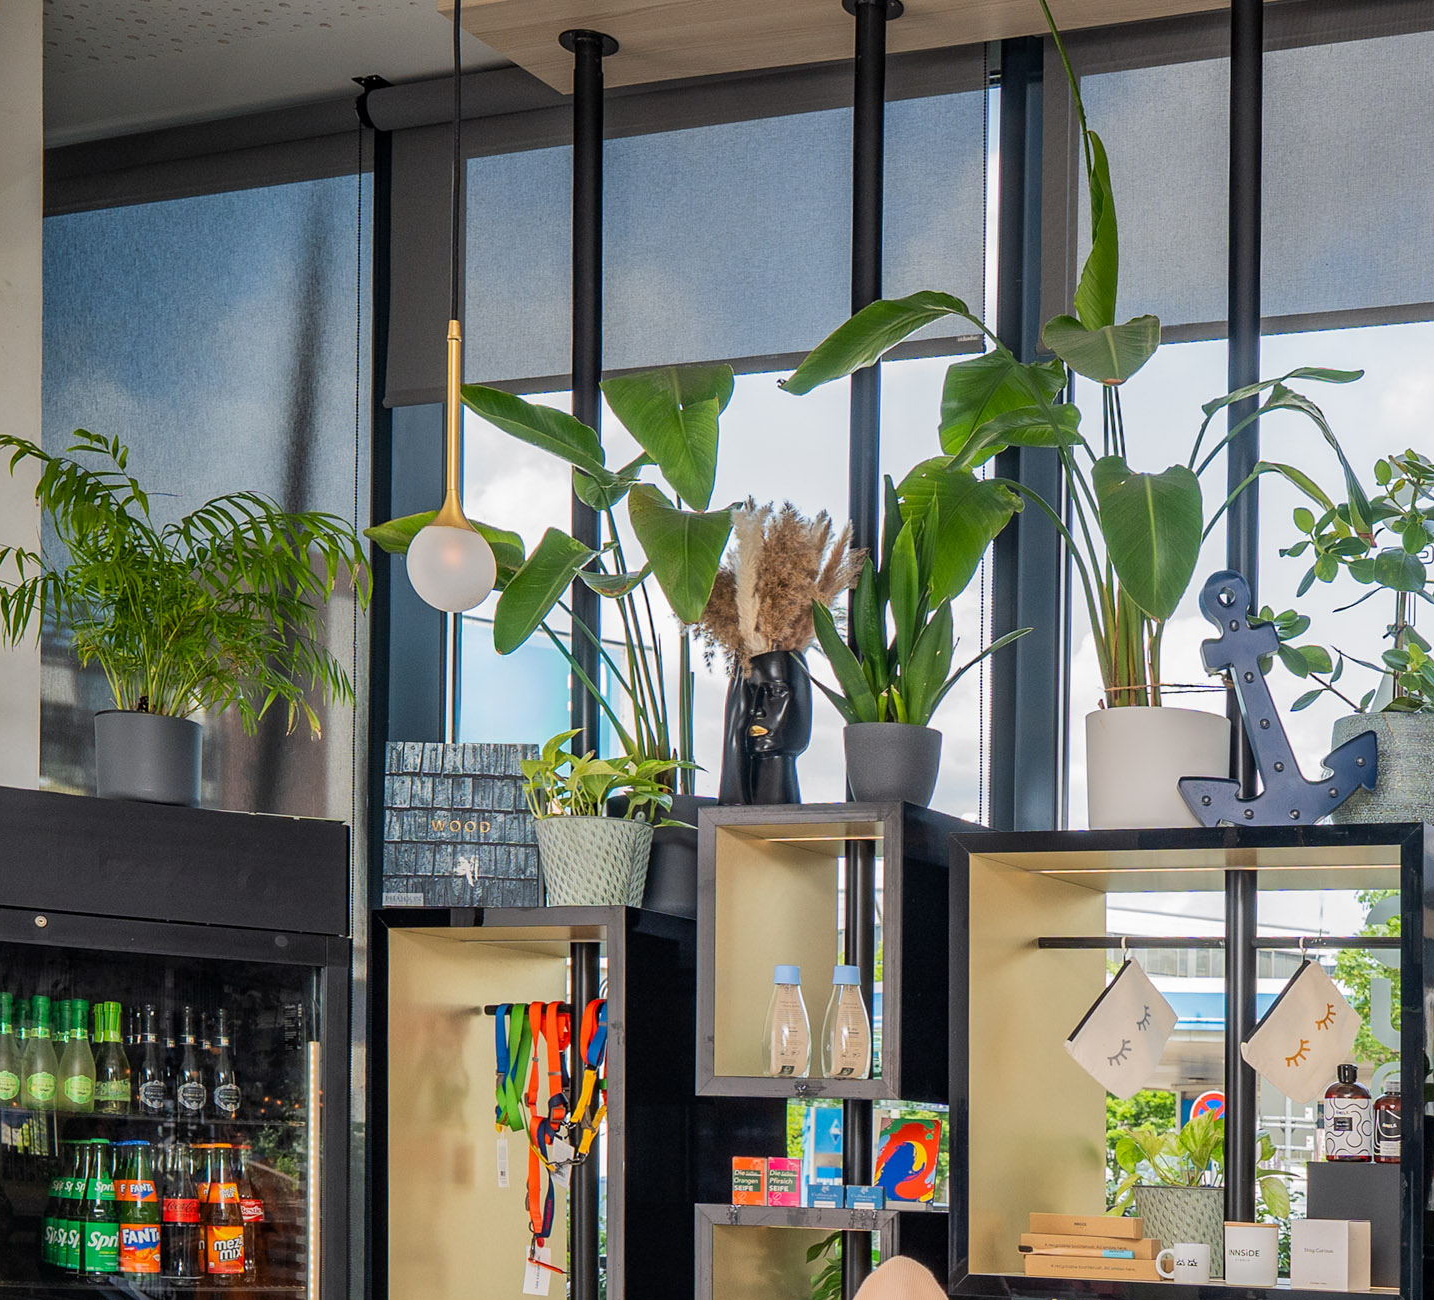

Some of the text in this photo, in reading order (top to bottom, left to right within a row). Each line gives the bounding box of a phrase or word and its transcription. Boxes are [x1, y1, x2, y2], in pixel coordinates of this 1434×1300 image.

[431, 819, 492, 834] WOOD
[734, 1169, 746, 1177] Die
[768, 1169, 781, 1177] Die
[96, 1182, 114, 1193] Spri
[87, 1231, 119, 1251] Spri
[219, 1248, 243, 1262] mix
[1304, 1247, 1315, 1255] Stay
